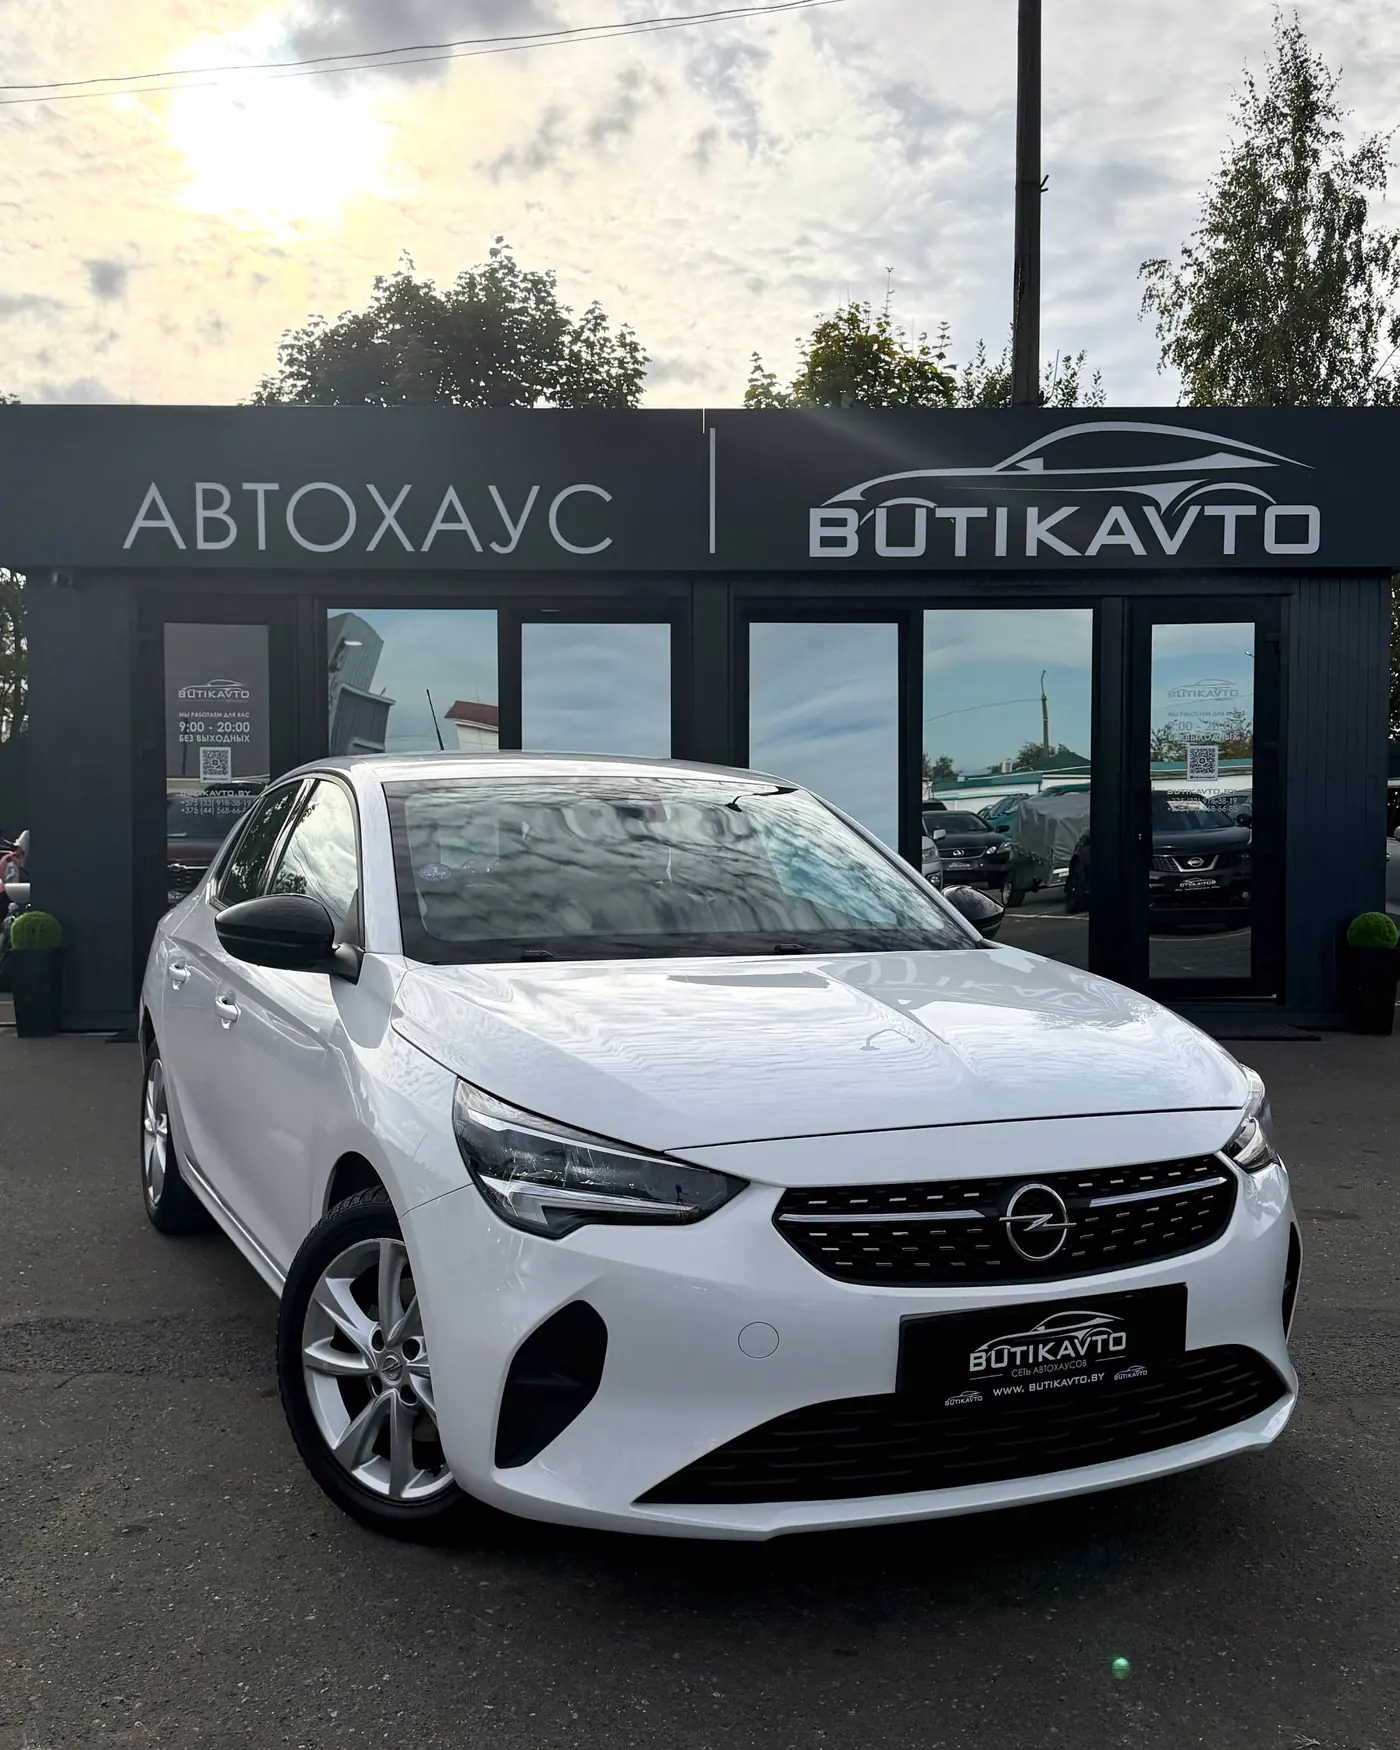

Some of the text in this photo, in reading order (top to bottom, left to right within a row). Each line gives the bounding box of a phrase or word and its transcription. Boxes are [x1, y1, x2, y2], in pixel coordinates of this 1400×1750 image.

[123, 481, 614, 555] АВТОХАУС
[809, 504, 1321, 558] BUTIKAVTO
[178, 689, 250, 699] BUTIKAVTO
[1168, 689, 1239, 698] BUTIKAVTO
[179, 721, 205, 733] 9:00
[217, 721, 250, 733] 20:00
[179, 734, 250, 743] БЕЗ ВЫХОДНЫХ
[215, 807, 248, 815] 568-66-
[969, 1331, 1127, 1372] BUTIKAVTO
[1011, 1359, 1088, 1378] СЕТЬ АВТОХАУСОВ
[1114, 1369, 1148, 1381] BUTIKAVTO
[944, 1395, 983, 1407] BUTIKAVTO
